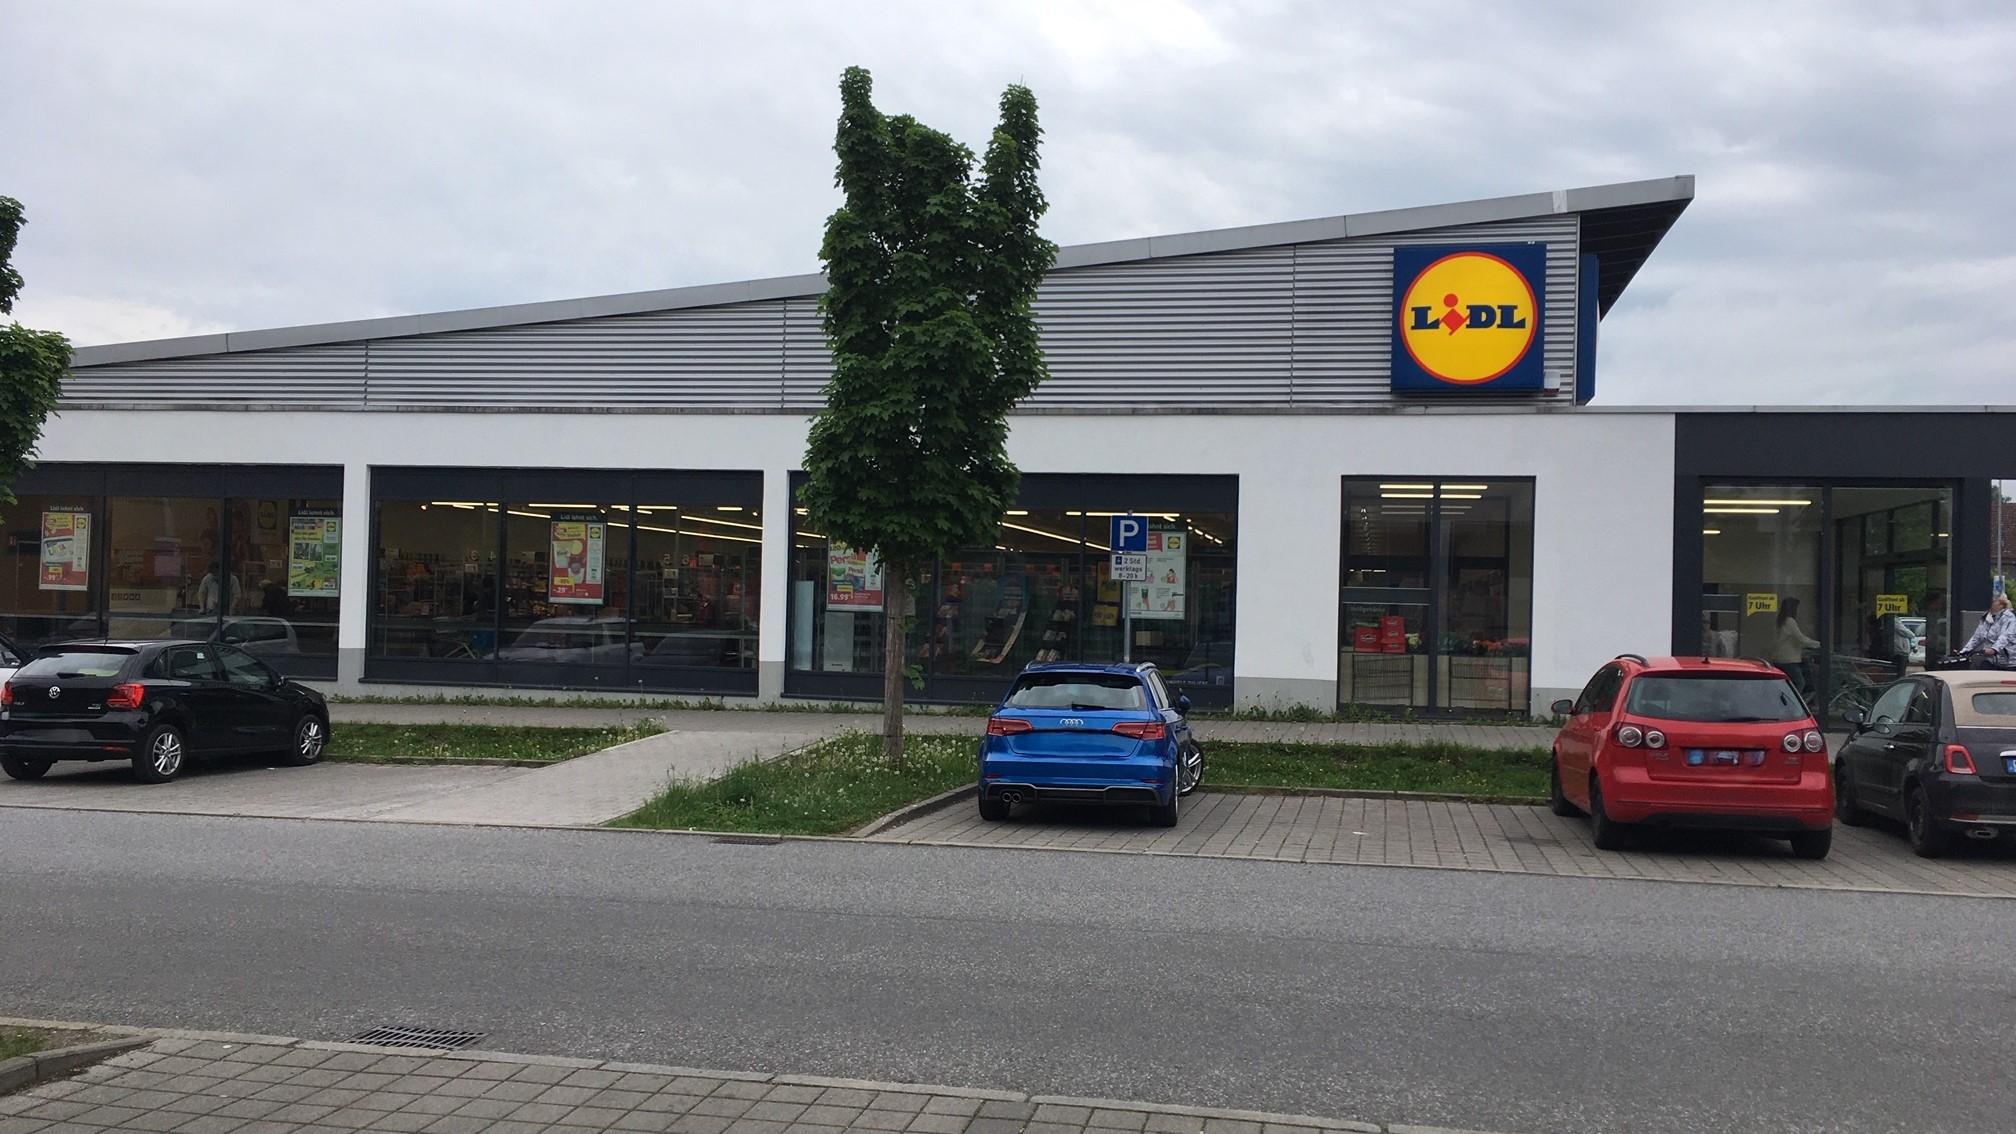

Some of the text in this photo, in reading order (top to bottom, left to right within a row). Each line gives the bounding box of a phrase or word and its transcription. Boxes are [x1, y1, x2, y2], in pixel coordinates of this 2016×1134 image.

[1119, 519, 1140, 547] P
[1123, 557, 1129, 565] 2
[1755, 601, 1771, 610] Uhr
[1885, 603, 1901, 612] Uhr
